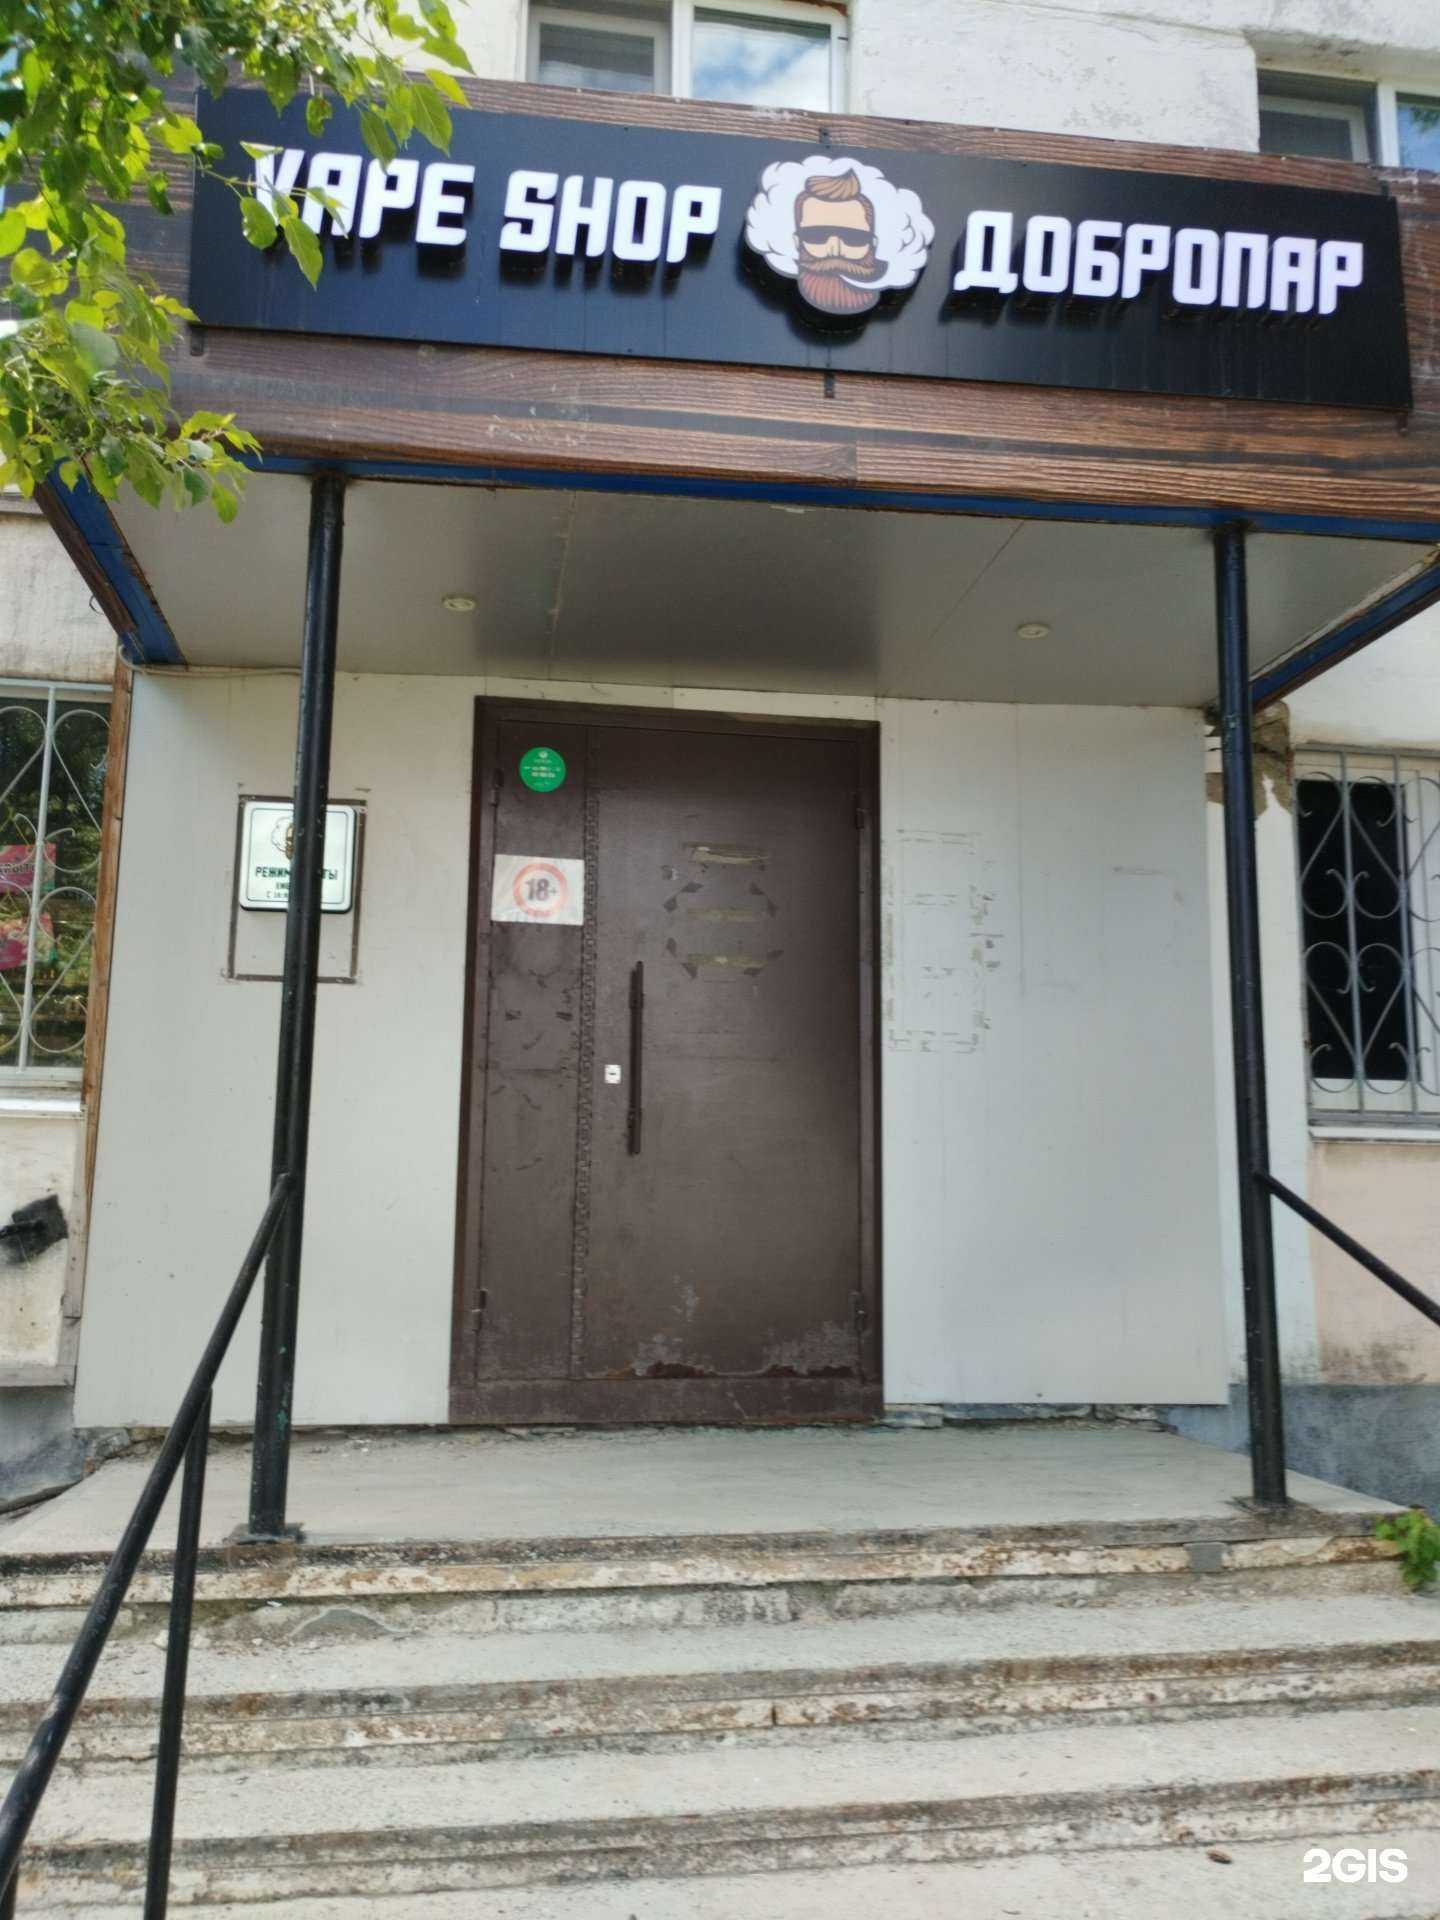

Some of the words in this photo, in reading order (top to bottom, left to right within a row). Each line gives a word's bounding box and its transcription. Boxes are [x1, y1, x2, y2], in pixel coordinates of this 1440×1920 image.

[251, 146, 475, 245] VAPE
[499, 170, 722, 263] SHOP
[953, 210, 1363, 314] ДОБРОПАР
